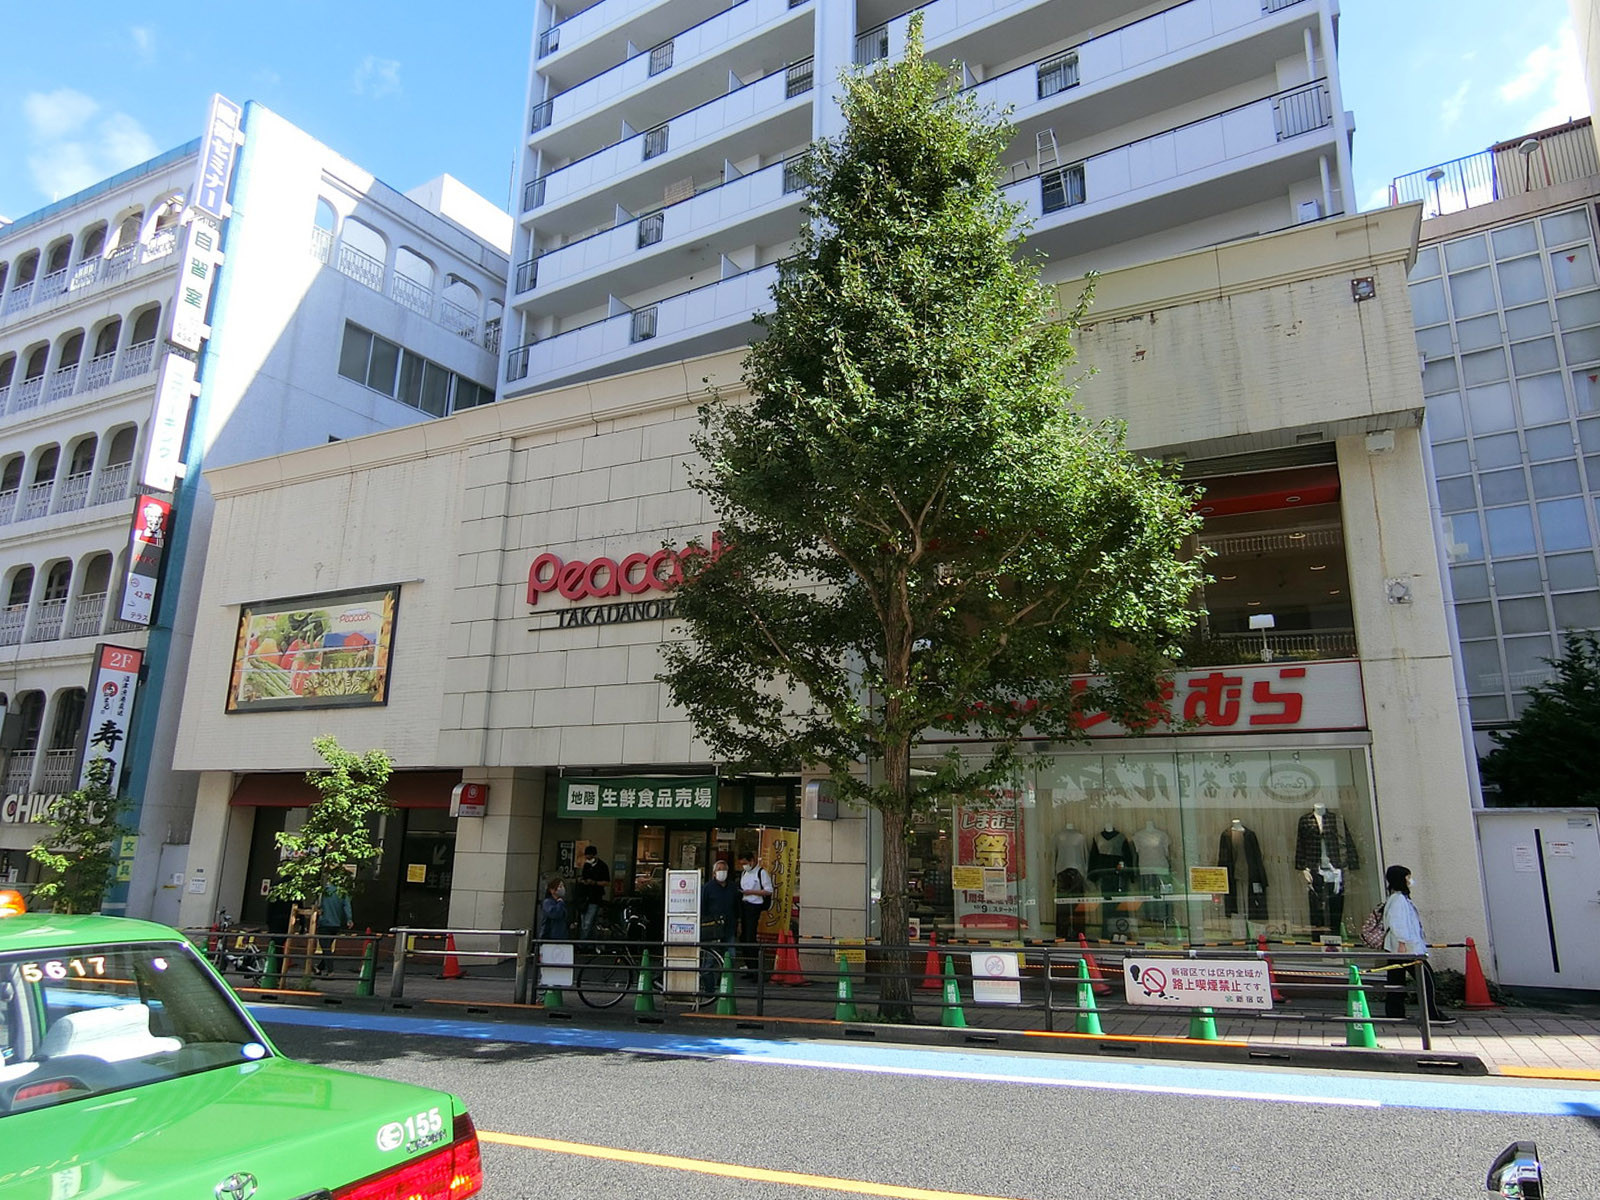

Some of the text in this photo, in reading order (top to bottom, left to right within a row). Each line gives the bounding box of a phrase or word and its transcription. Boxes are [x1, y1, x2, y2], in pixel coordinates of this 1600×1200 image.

[204, 102, 238, 208] セミナー
[110, 652, 133, 668] 2F
[571, 787, 712, 809] 地階 生鮮食品売場
[22, 956, 105, 983] 5617
[1171, 967, 1264, 978] 新宿区では区内全域が
[1172, 979, 1267, 993] 路上喫煙禁止です。
[1236, 995, 1265, 1004] 新宿区
[404, 1107, 442, 1140] 155
